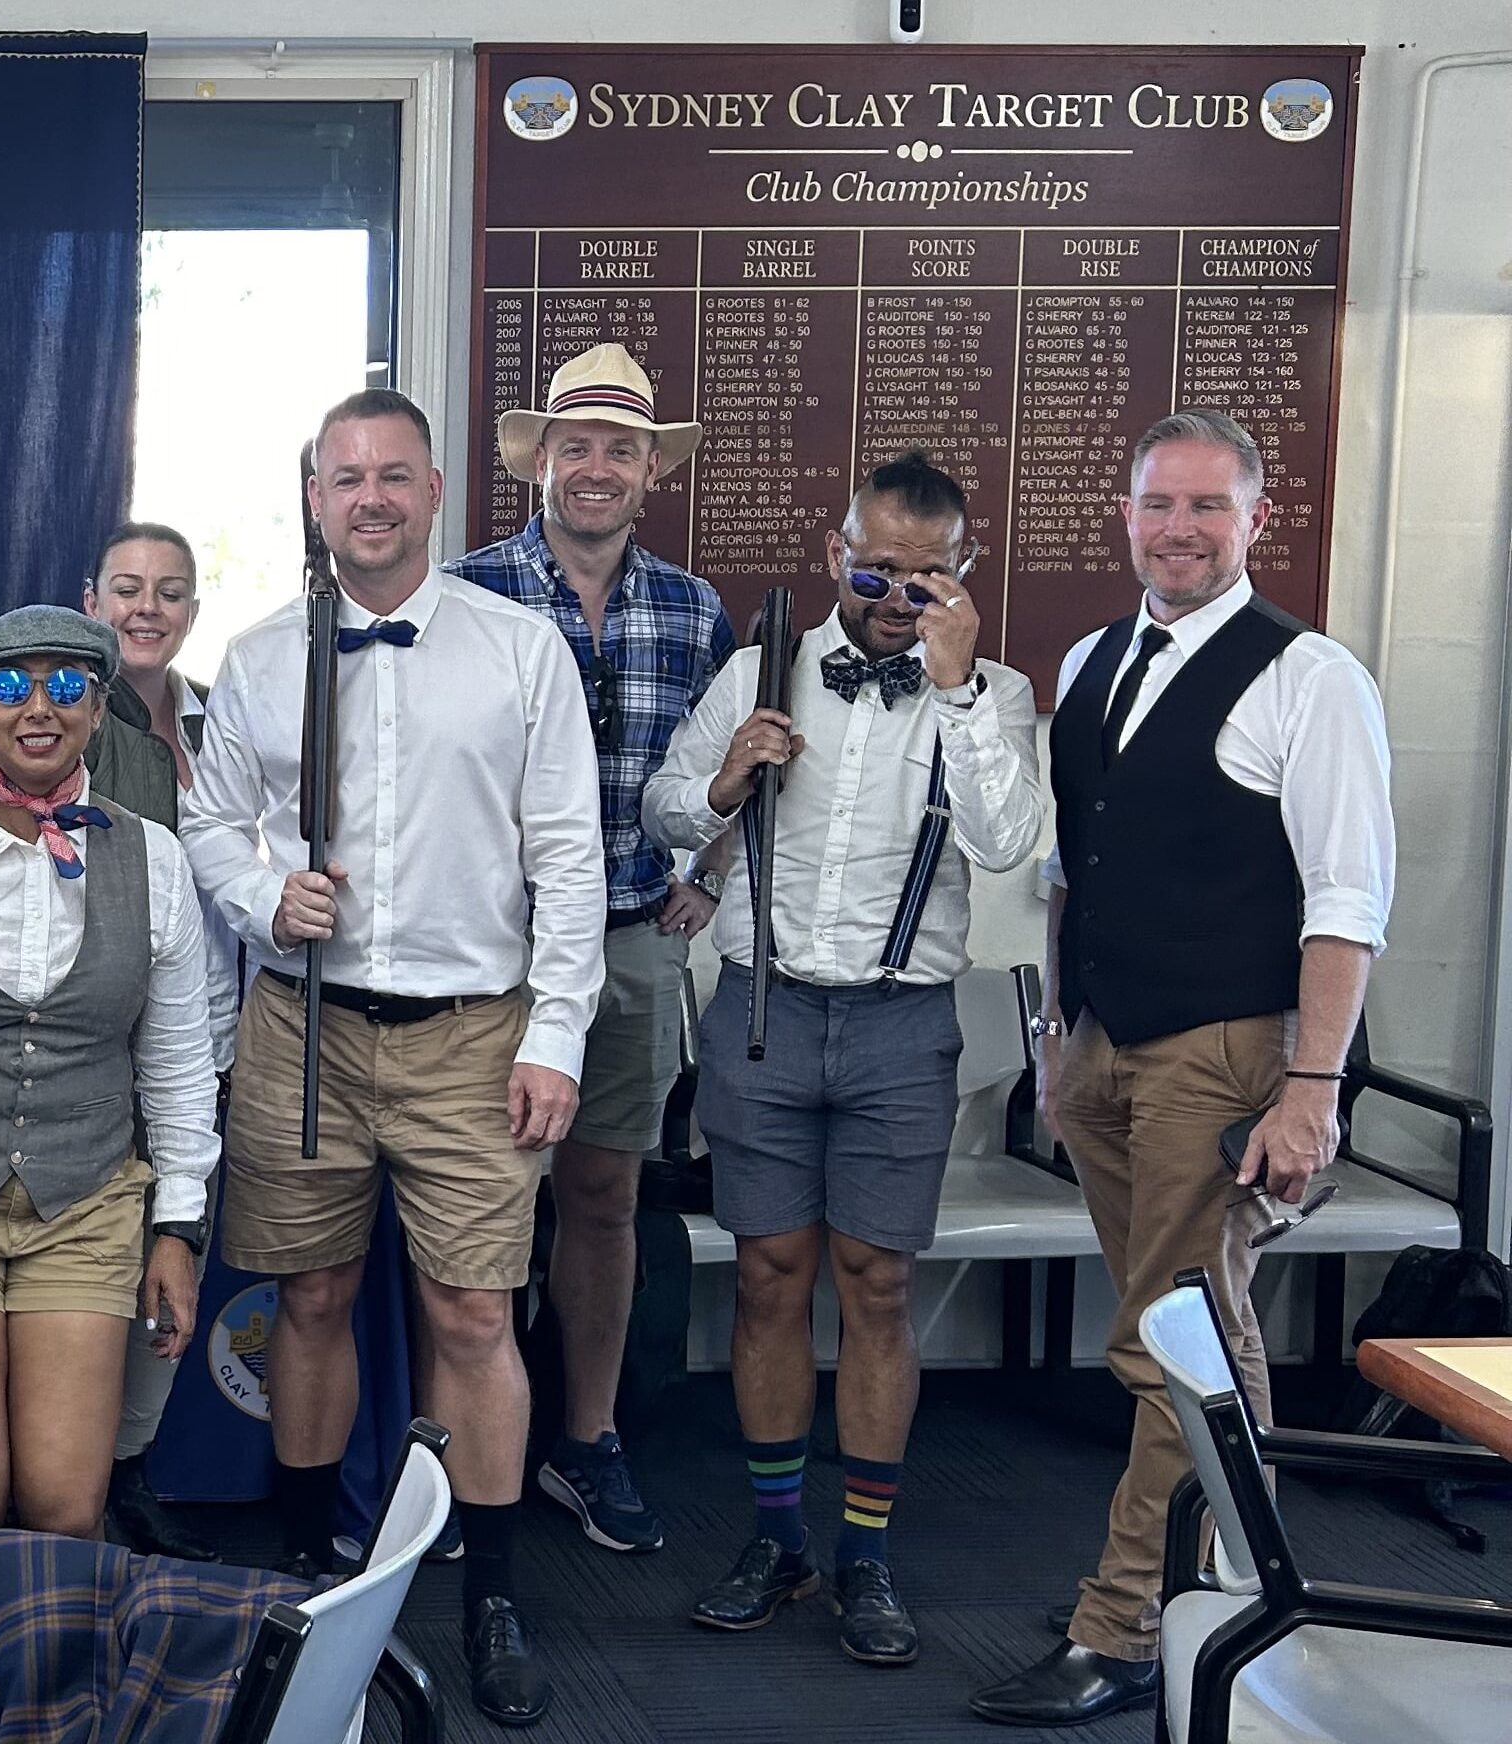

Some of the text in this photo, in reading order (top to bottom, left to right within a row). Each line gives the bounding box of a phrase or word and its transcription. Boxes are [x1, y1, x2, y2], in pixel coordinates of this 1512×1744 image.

[747, 171, 1088, 209] Club Championships
[580, 241, 657, 257] DOUBLE
[747, 240, 814, 256] SINGLE
[908, 240, 975, 255] POINTS
[1063, 240, 1139, 255] DOUBLE
[1201, 239, 1319, 259] CHAMPION of
[581, 263, 654, 278] BARREL
[743, 262, 816, 277] BARREL
[912, 261, 970, 277] SCORE
[1080, 261, 1120, 277] RISE
[1203, 261, 1312, 276] CHAMPIONS
[497, 300, 521, 309] 2005
[556, 299, 607, 309] LYSAGHT
[616, 299, 628, 308] 50
[638, 299, 651, 308] 50
[718, 298, 765, 308] ROOTES
[775, 298, 785, 308] 61
[797, 298, 809, 308] 62
[878, 298, 916, 307] FROST
[926, 298, 943, 307] 149
[954, 297, 971, 307] 150
[1196, 297, 1238, 306] ALVARO
[1248, 297, 1265, 306] 144
[1276, 297, 1294, 306] 150
[496, 314, 521, 324] 2006
[554, 313, 597, 322] ALVARO
[608, 313, 625, 322] 138
[637, 312, 654, 322] 138
[877, 312, 933, 321] AUDITORE
[945, 312, 962, 321] 150
[973, 312, 990, 321] 150
[1037, 311, 1083, 321] SHERRY
[1092, 311, 1104, 321] 53
[1114, 311, 1126, 321] 60
[496, 328, 521, 338] 2007
[1196, 325, 1252, 335] AUDITORE
[1262, 325, 1278, 334] 121
[1291, 325, 1308, 334] 125
[496, 343, 520, 352] 2008
[493, 484, 517, 493] 2018
[712, 508, 788, 518] BOU-MOUSSA
[792, 508, 805, 517] 49
[815, 508, 827, 517] 52
[220, 1365, 250, 1399] CLAY
